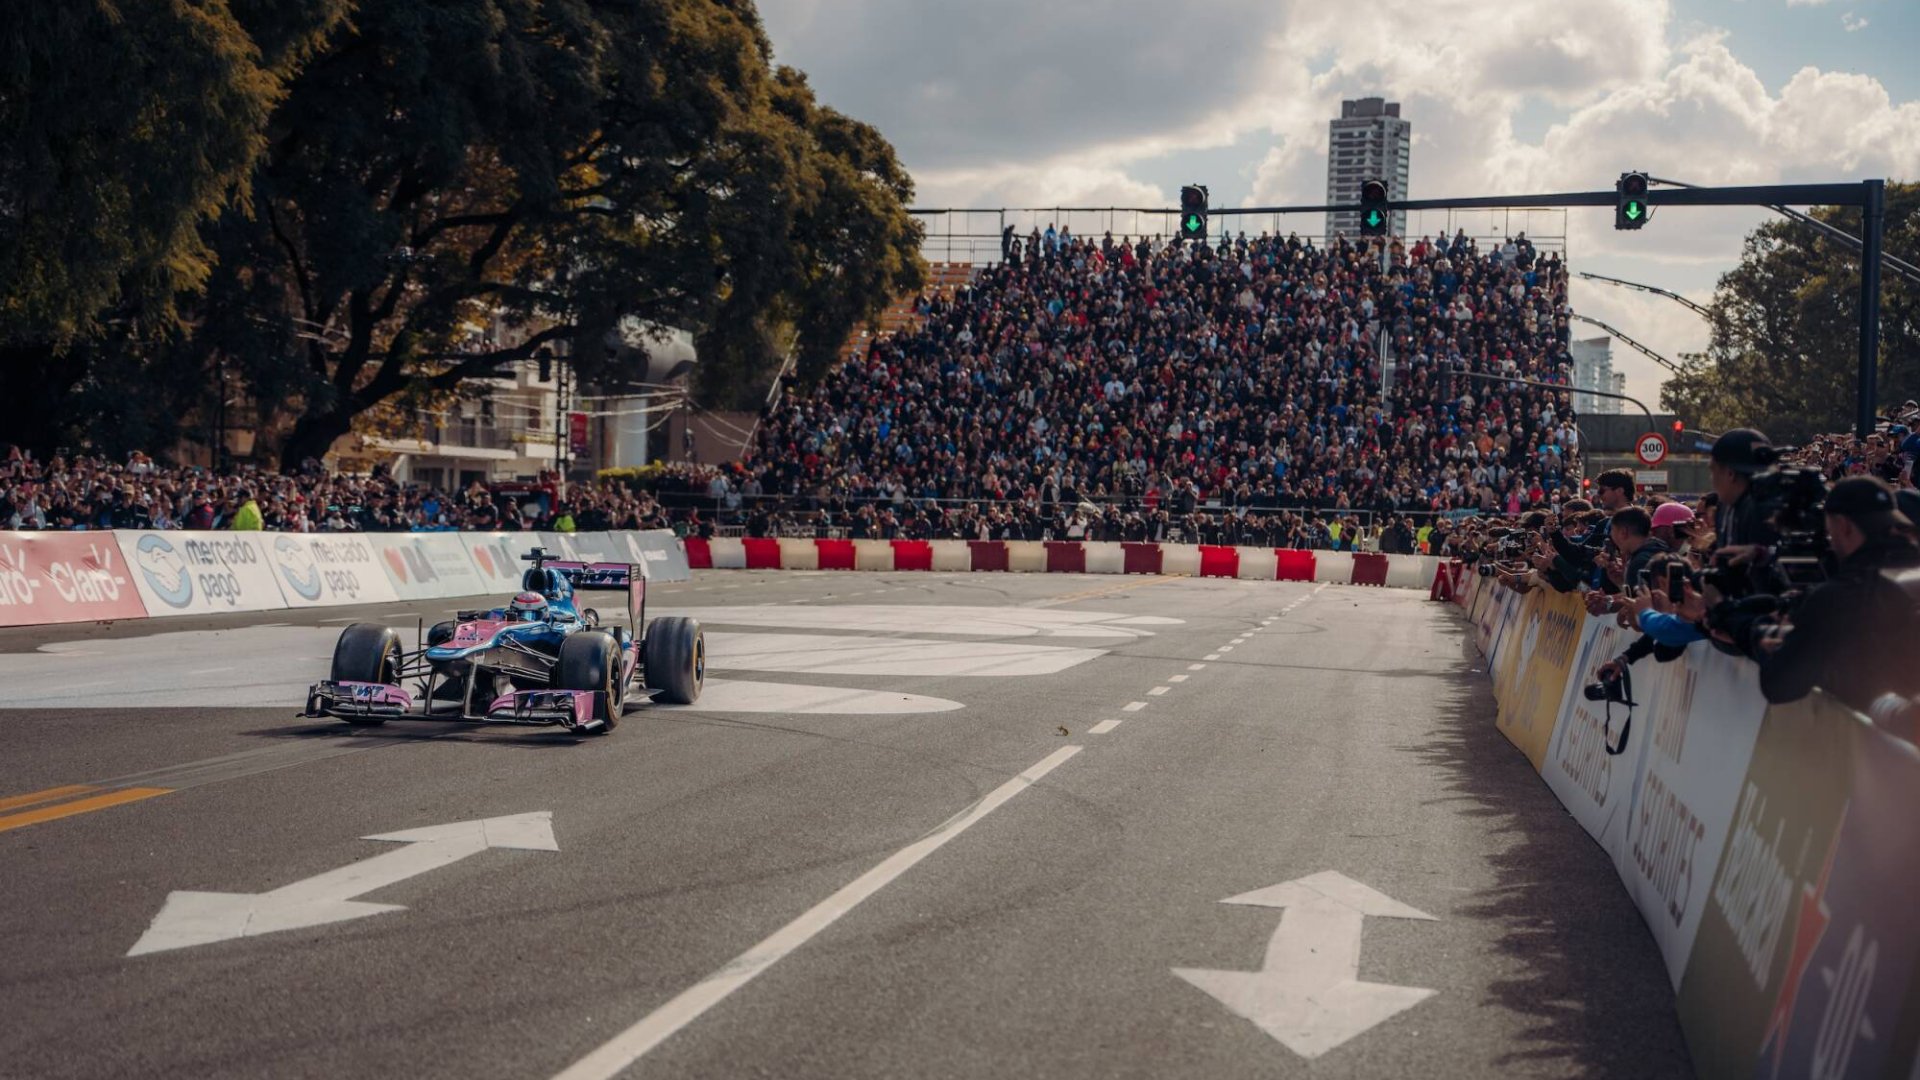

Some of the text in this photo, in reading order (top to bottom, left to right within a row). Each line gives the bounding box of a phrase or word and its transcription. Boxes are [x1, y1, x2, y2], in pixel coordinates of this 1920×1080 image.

[1642, 443, 1663, 454] 300
[185, 535, 257, 565] mercado
[310, 537, 370, 564] mercado
[50, 557, 121, 603] Claro
[200, 572, 242, 606] pago
[324, 570, 361, 599] pago
